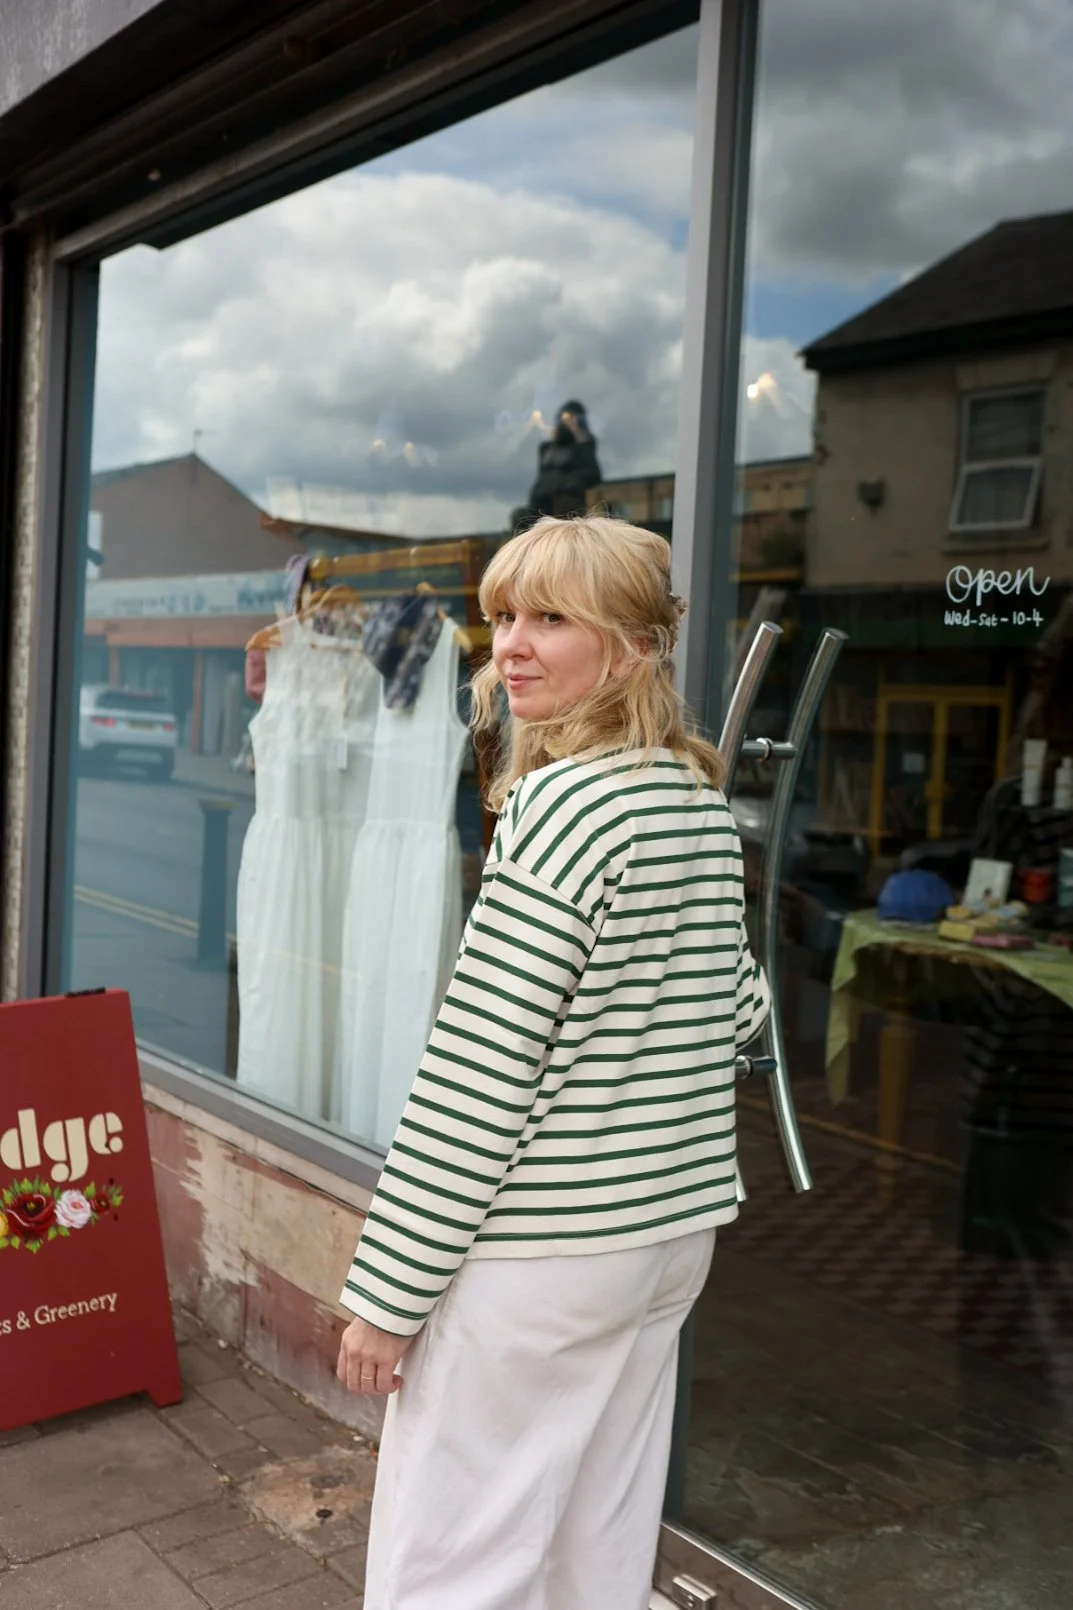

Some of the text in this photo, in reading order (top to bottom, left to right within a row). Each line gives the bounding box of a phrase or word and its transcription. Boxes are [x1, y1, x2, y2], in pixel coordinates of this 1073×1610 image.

[945, 565, 1051, 607] Open
[16, 1310, 31, 1330] &
[34, 1292, 118, 1325] Greenery
